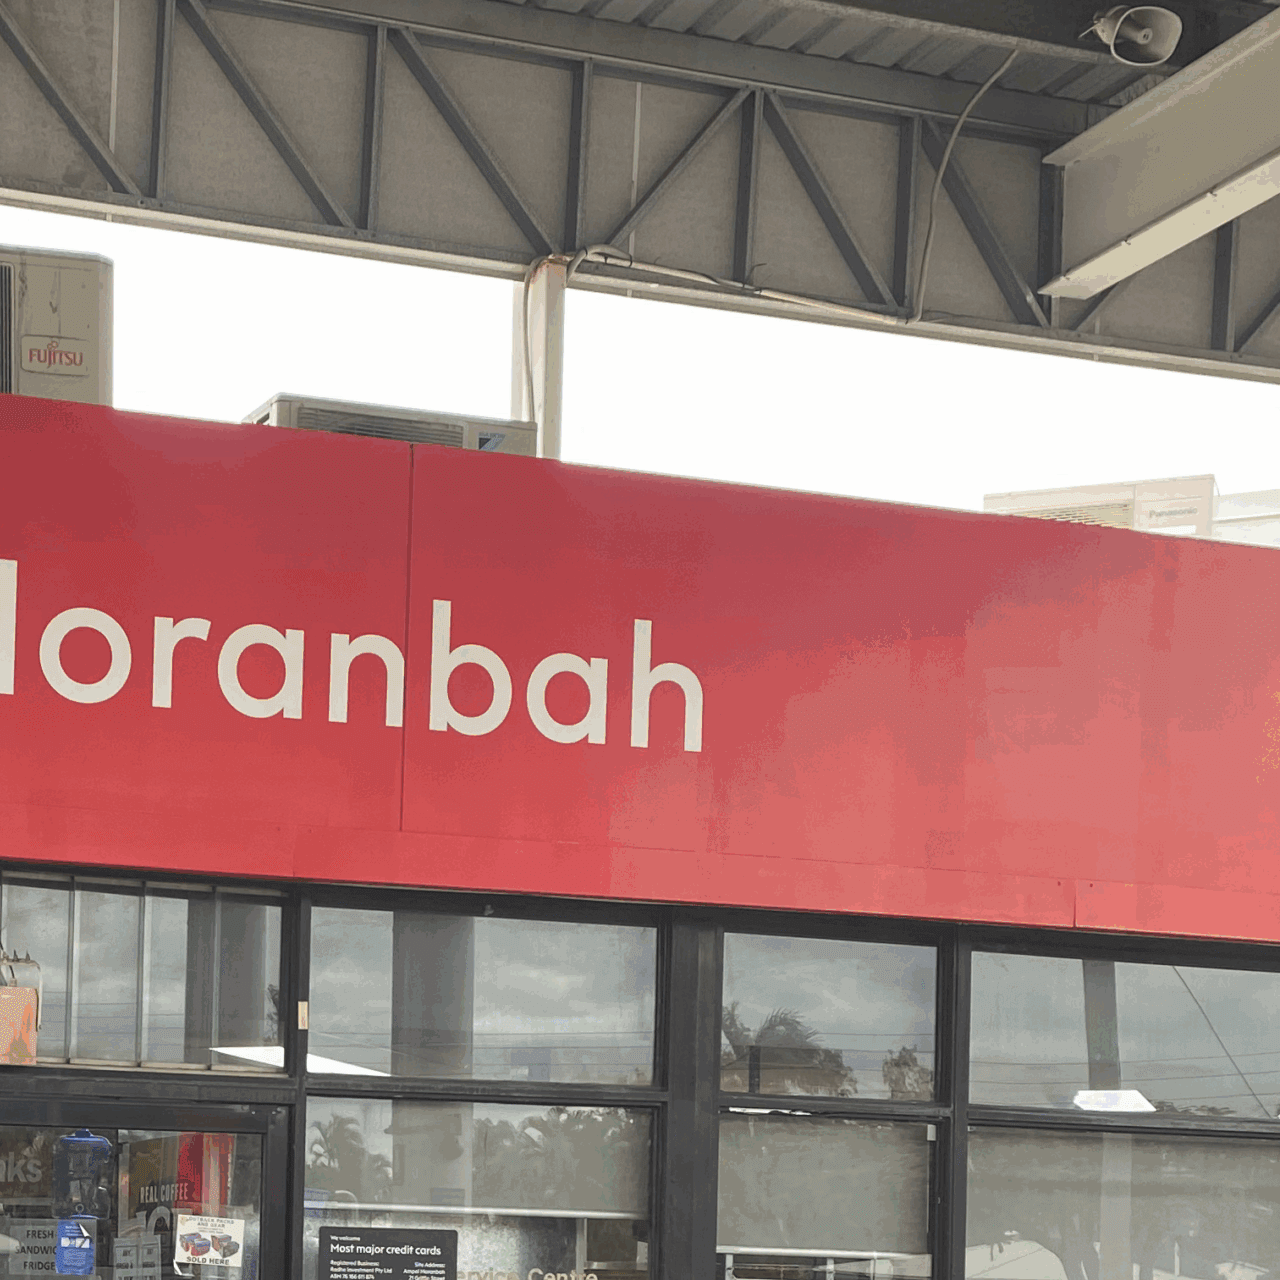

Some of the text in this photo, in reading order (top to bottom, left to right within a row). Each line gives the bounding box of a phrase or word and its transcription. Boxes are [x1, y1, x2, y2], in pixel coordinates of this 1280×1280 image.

[28, 345, 83, 368] FUJITSU
[140, 1182, 188, 1203] REAL COFFEE
[27, 1230, 54, 1239] FRESH
[330, 1244, 441, 1256] Most major credit cards
